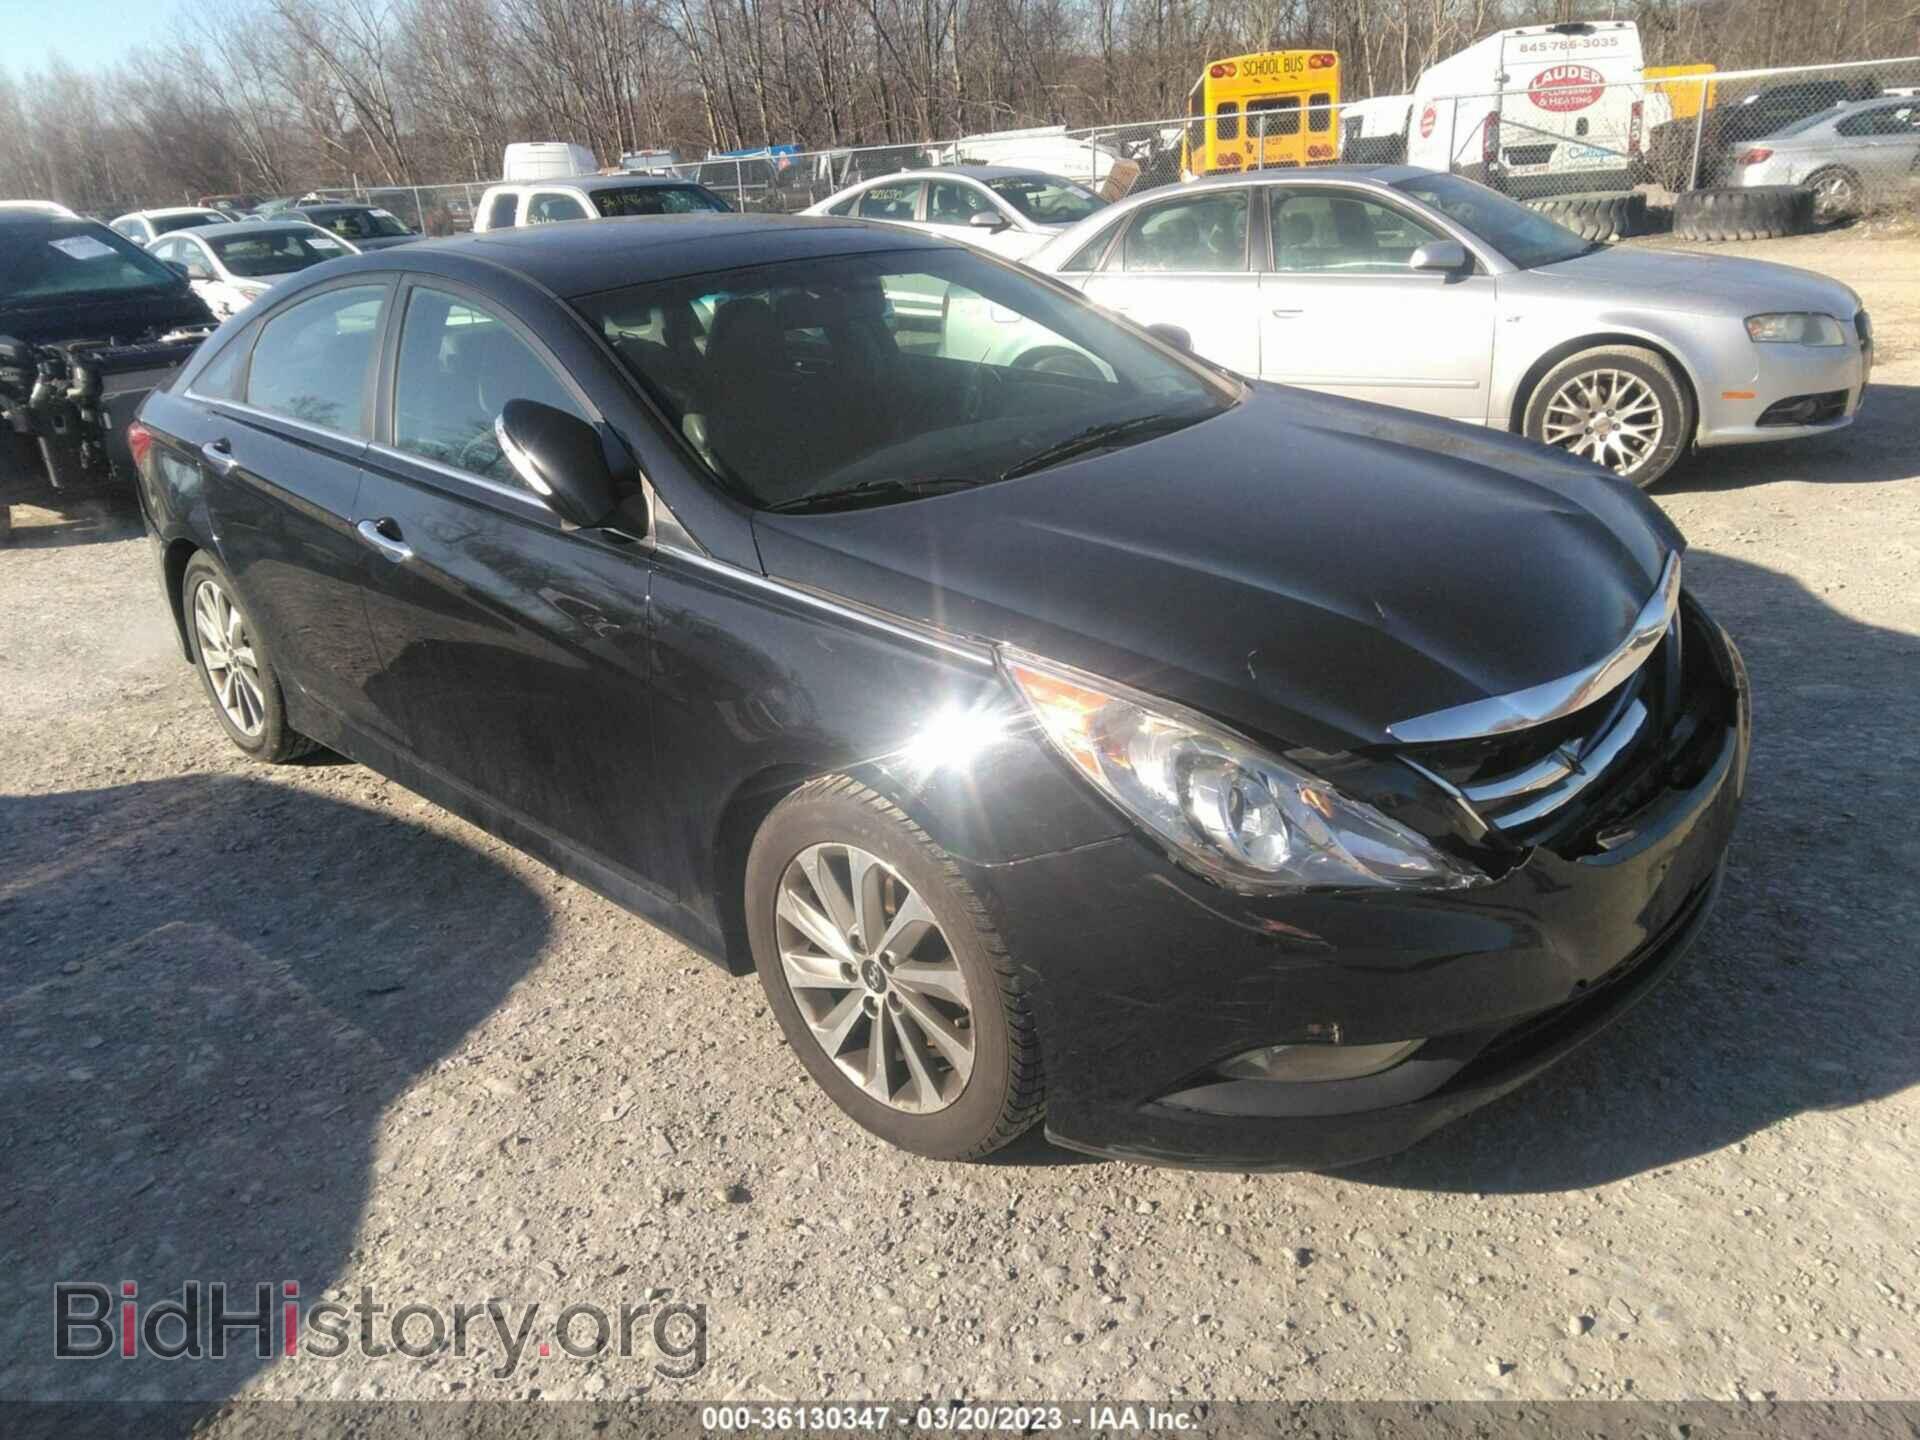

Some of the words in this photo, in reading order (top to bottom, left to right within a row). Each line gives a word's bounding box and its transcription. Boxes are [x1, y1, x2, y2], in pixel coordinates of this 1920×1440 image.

[1242, 57, 1281, 76] SCHOOL
[1283, 55, 1304, 73] BUS
[1532, 66, 1602, 88] LAUDER
